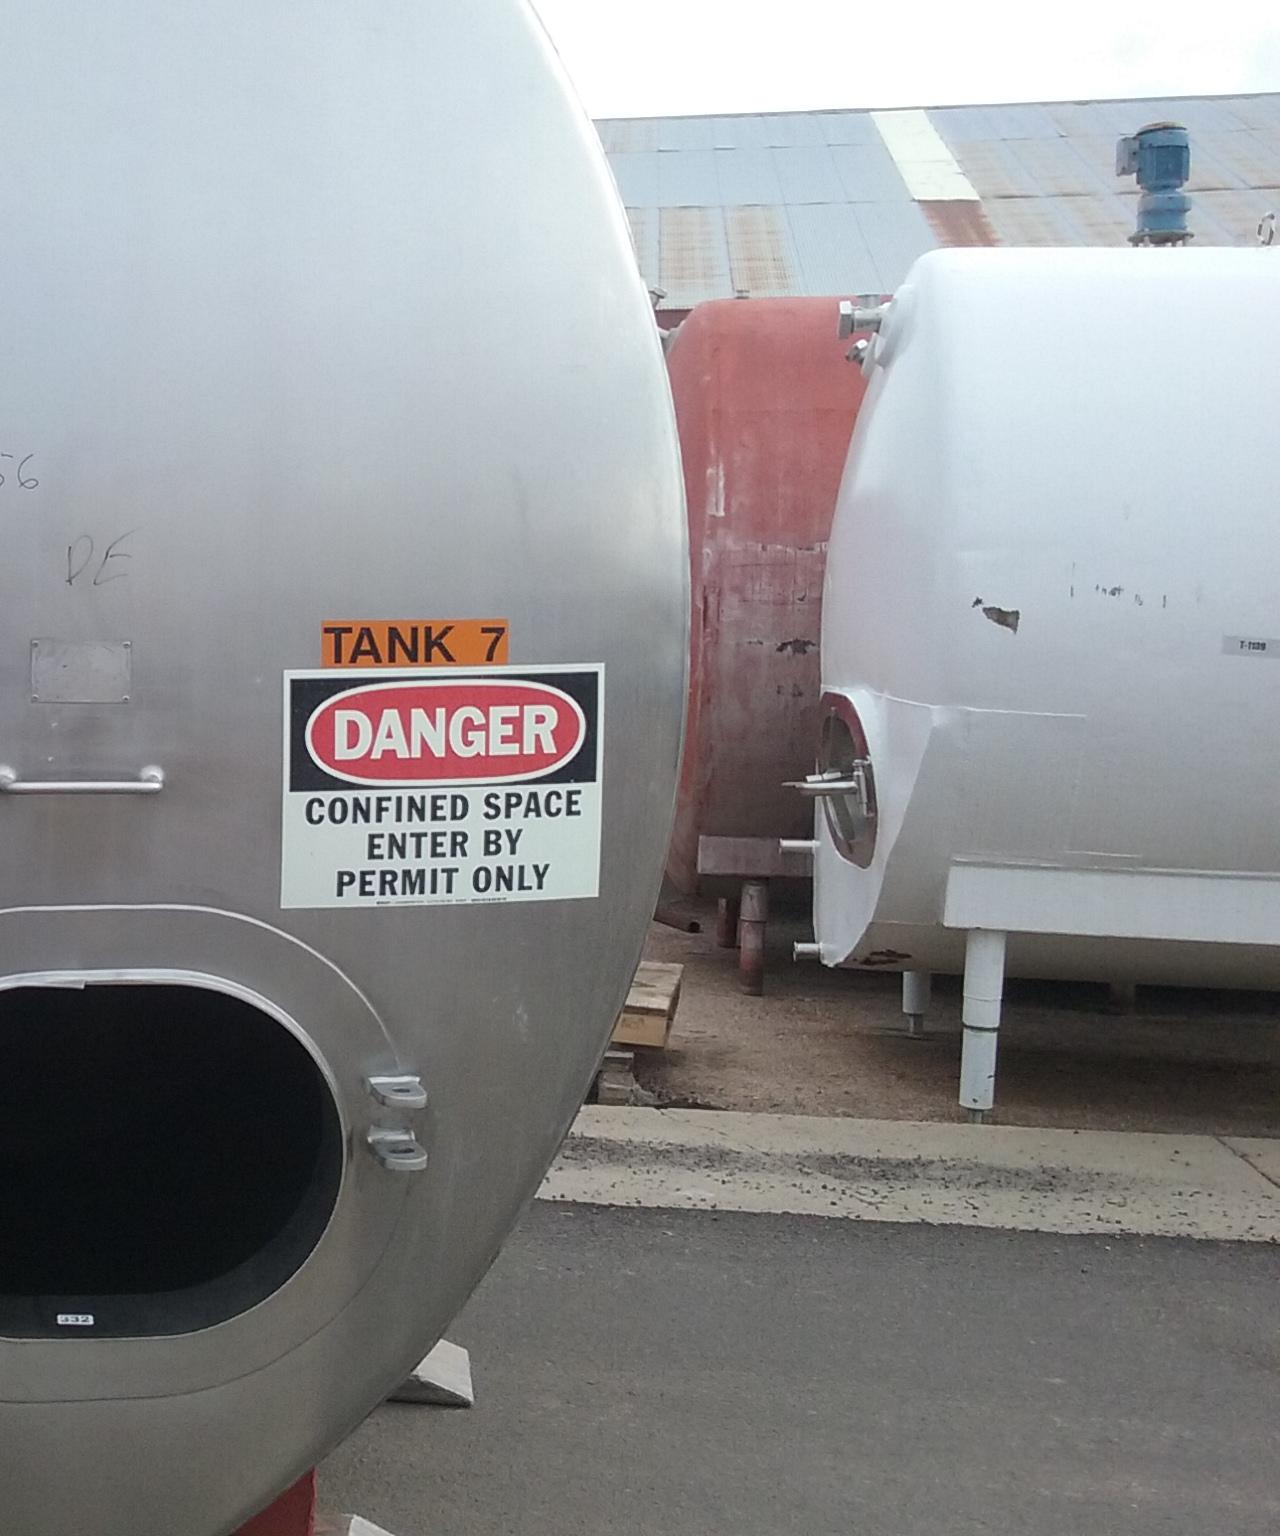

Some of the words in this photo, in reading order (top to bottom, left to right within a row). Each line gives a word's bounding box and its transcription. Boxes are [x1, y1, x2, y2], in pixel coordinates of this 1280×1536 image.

[323, 625, 456, 664] TANK
[480, 626, 507, 663] 7
[333, 704, 559, 761] DANGER
[305, 794, 470, 825] CONFINED
[482, 790, 582, 821] SPACE
[367, 831, 469, 861] ENTER
[483, 828, 523, 856] BY
[336, 868, 459, 897] PERMIT
[472, 864, 551, 893] ONLY
